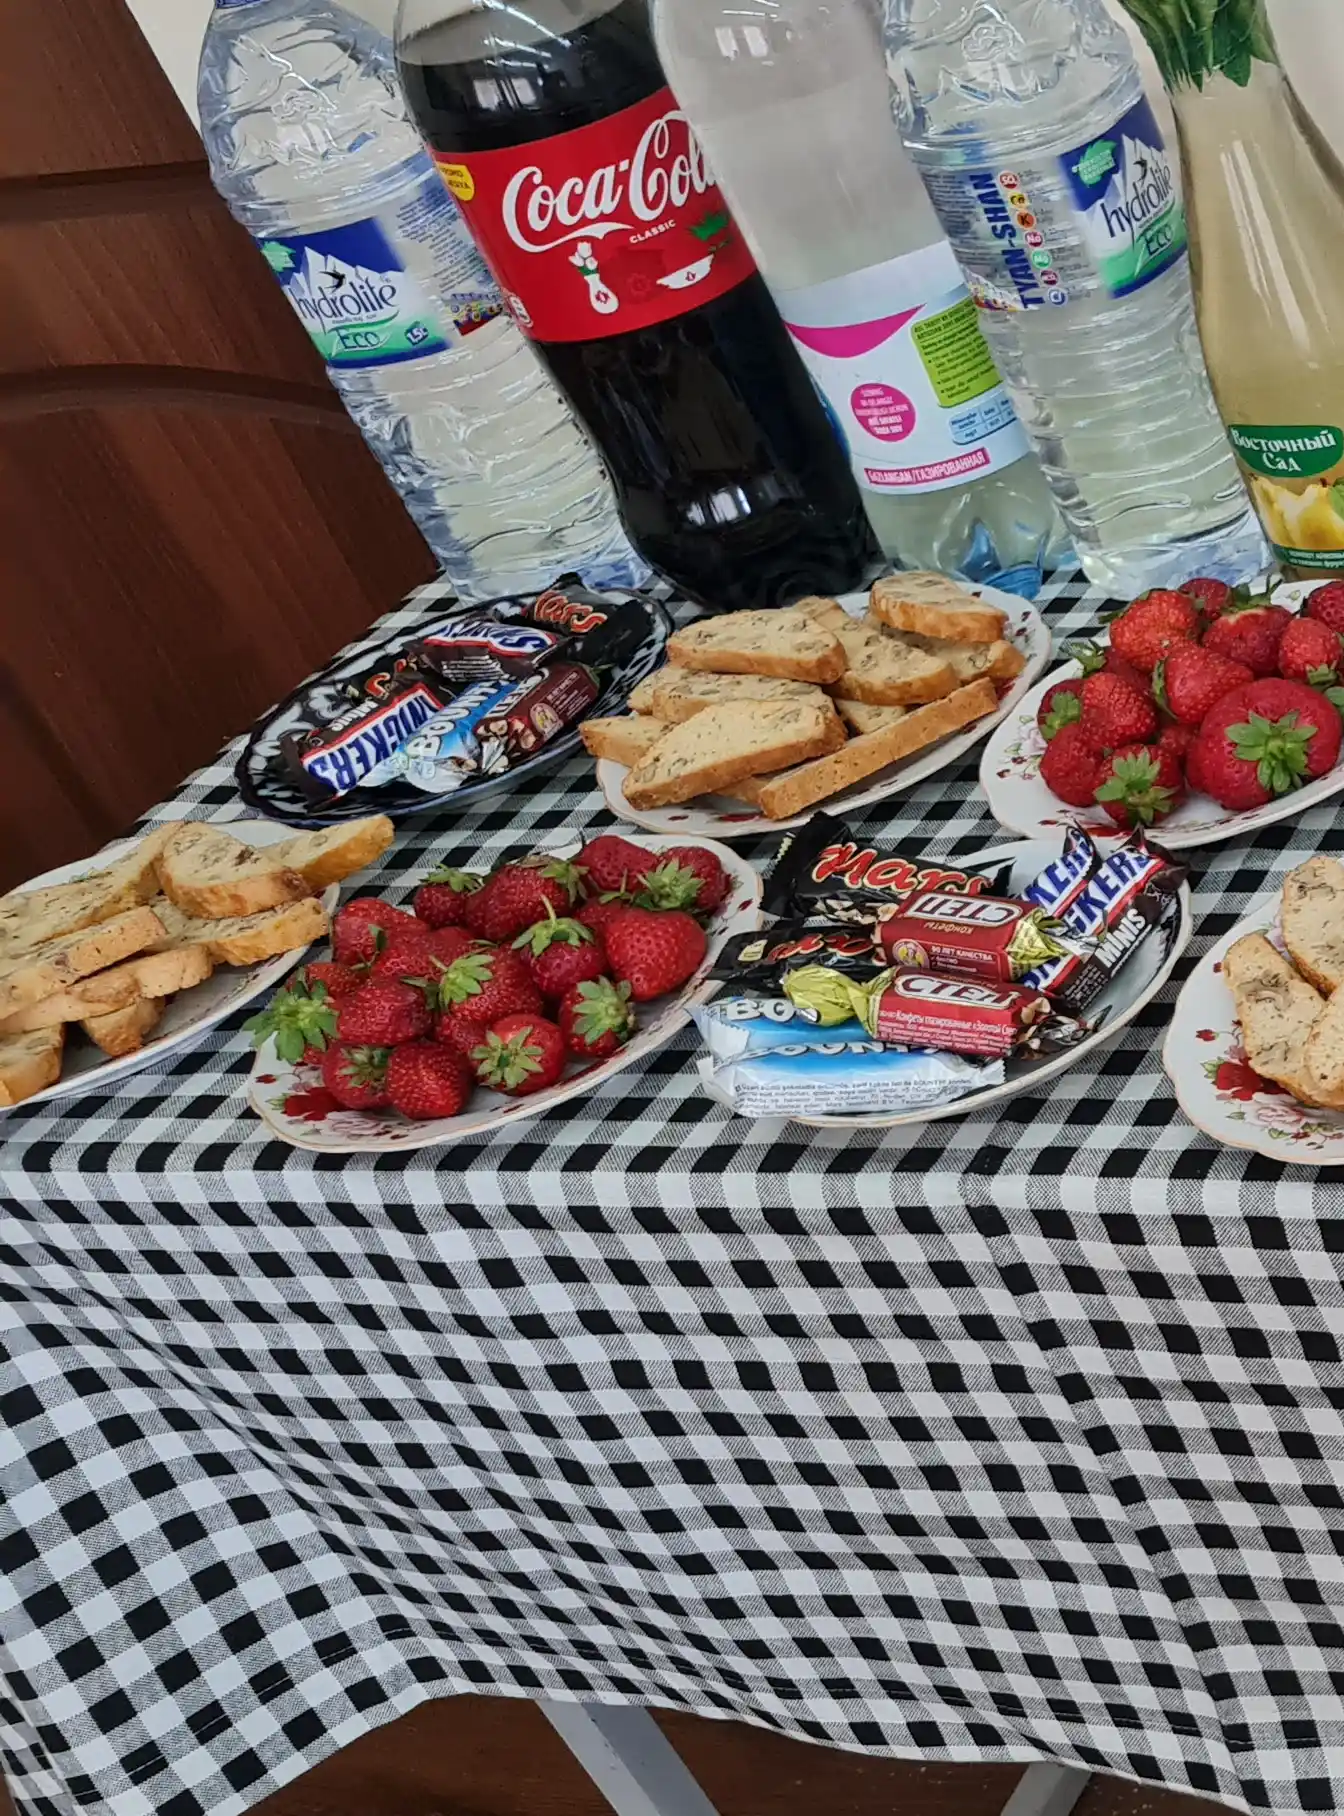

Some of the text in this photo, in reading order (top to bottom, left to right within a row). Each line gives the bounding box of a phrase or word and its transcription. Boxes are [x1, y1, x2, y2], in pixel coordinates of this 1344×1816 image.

[629, 219, 677, 244] CLASSIC
[969, 173, 1046, 309] TYAN-SHAN
[1230, 427, 1337, 453] Восточный
[1261, 452, 1302, 473] Сад
[1095, 908, 1146, 968] MINIS
